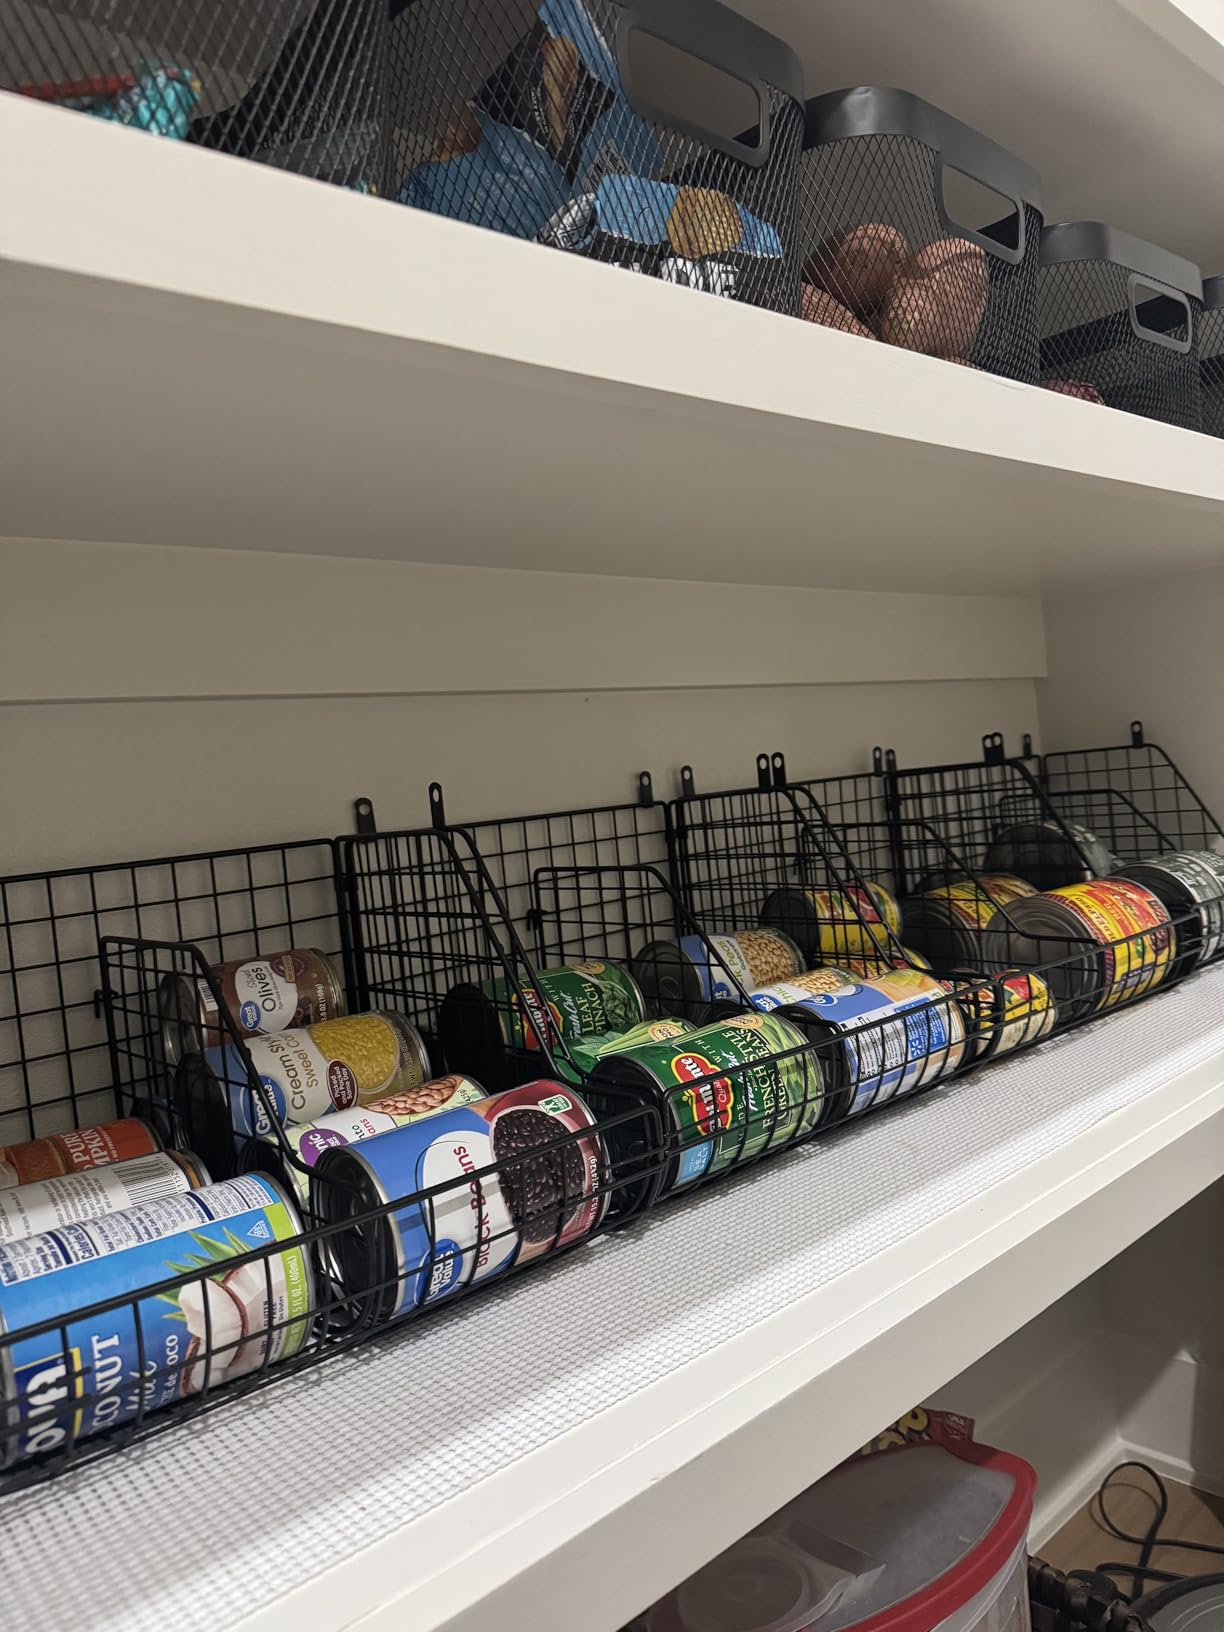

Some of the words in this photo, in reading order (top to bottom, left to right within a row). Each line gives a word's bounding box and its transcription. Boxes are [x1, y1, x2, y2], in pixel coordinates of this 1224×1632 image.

[717, 941, 738, 967] Peas
[252, 967, 276, 1012] Olives
[245, 1006, 255, 1027] Great
[576, 996, 595, 1034] LEAF
[582, 982, 607, 1034] PINACH
[694, 1039, 723, 1063] WITH
[721, 1030, 758, 1064] STYLE
[280, 1053, 306, 1110] Cream
[293, 1049, 319, 1088] Sweet
[334, 1065, 346, 1091] Packed
[341, 1067, 350, 1081] Day
[329, 1075, 341, 1099] Picked
[344, 1081, 352, 1101] Same
[753, 1065, 775, 1128] FRENCH
[288, 1255, 300, 1284] (400mL)
[166, 1334, 178, 1366] OCO
[163, 1373, 178, 1388] de
